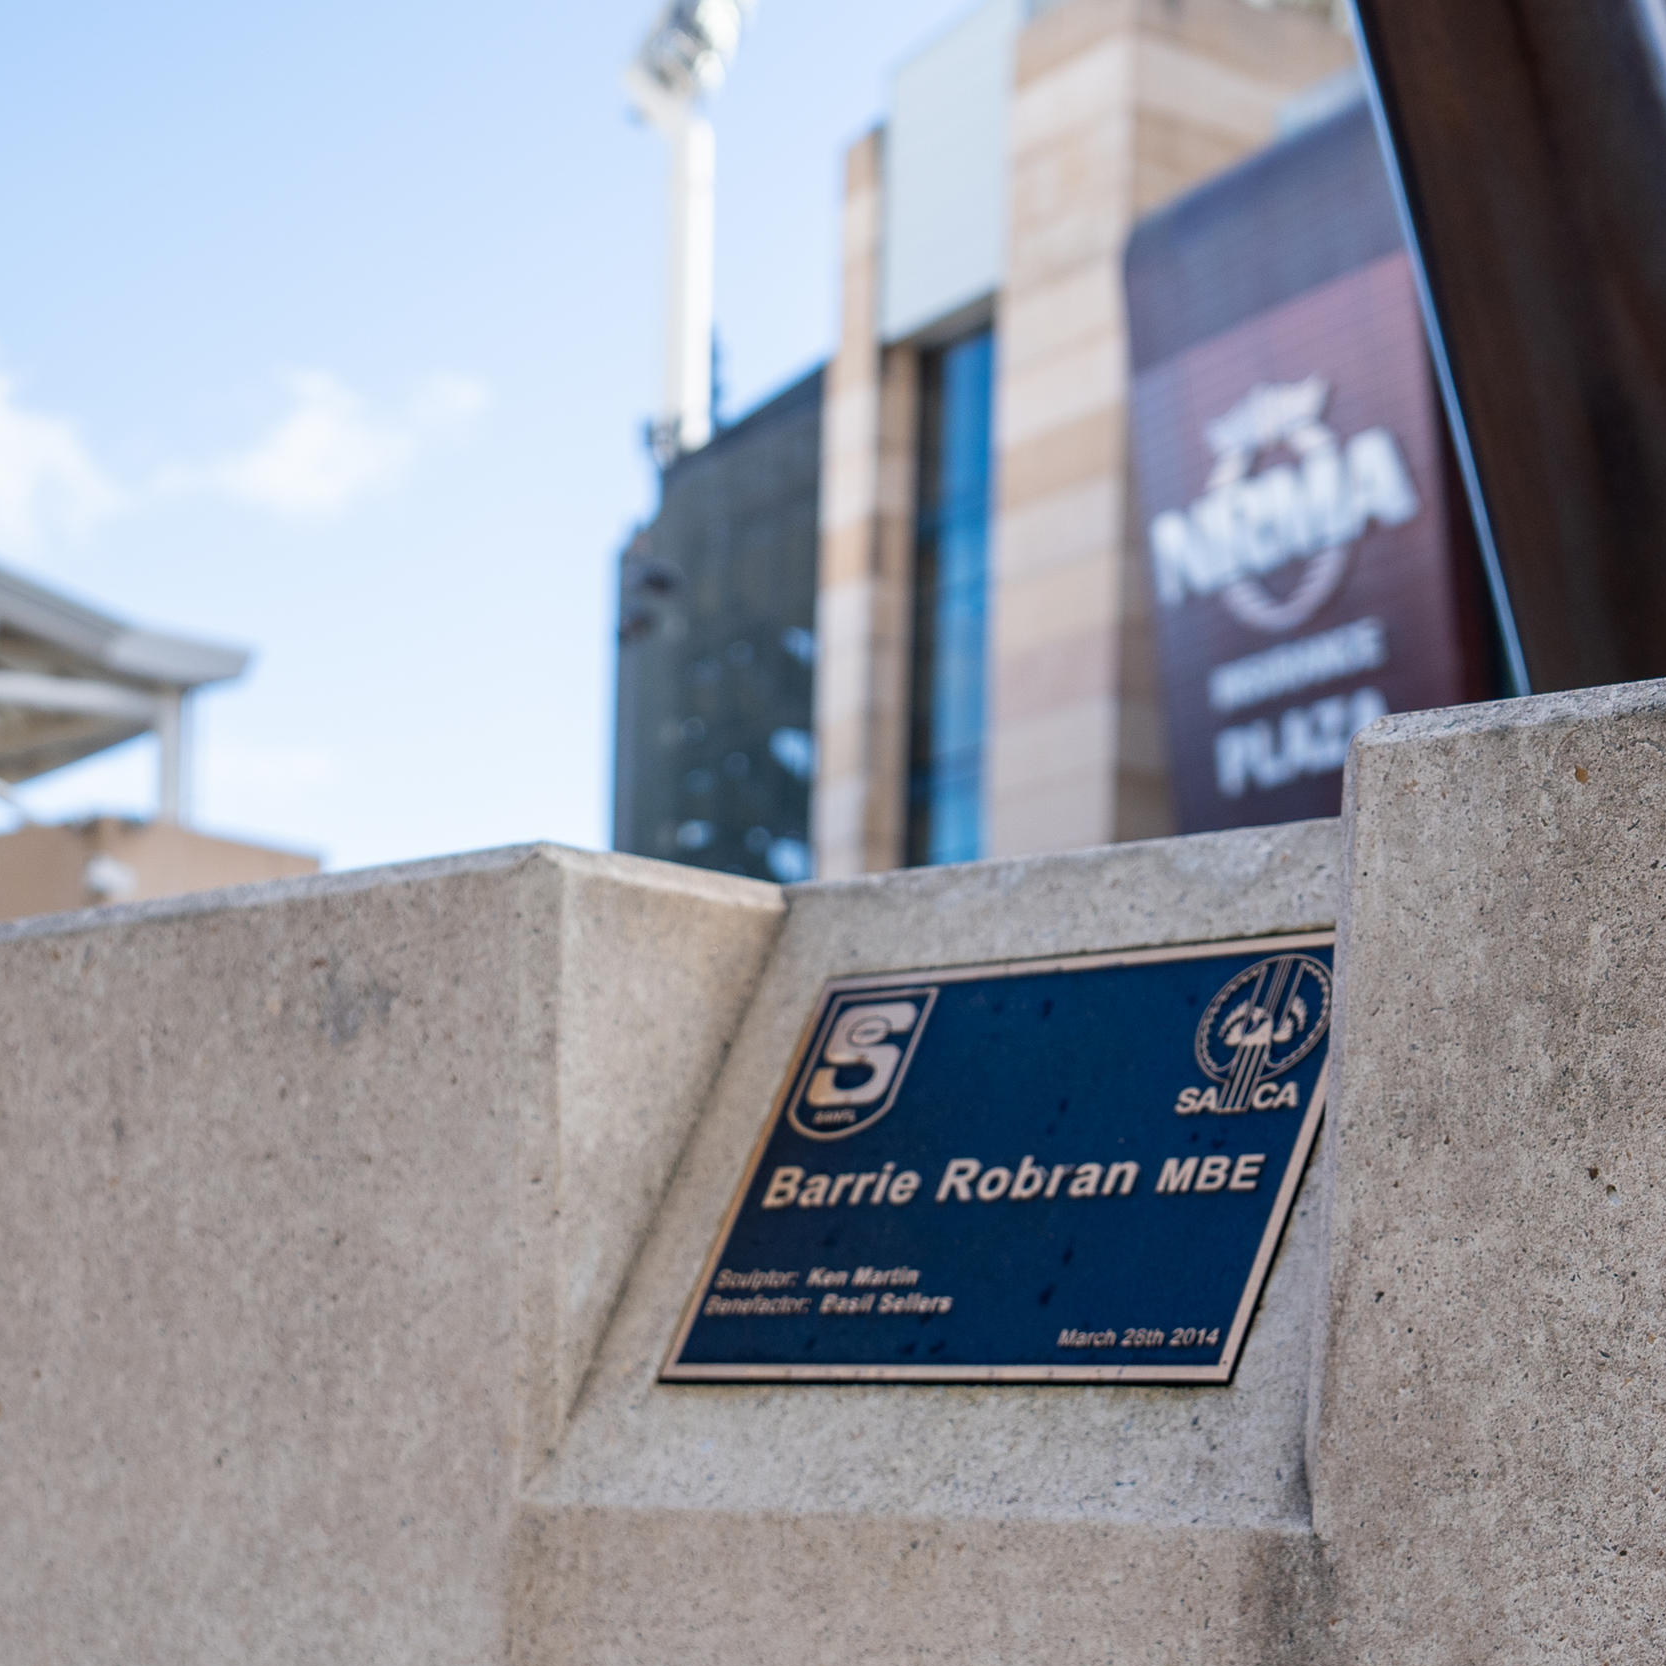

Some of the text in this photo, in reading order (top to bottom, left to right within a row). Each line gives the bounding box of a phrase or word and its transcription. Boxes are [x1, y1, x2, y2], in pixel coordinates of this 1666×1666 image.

[761, 1153, 1266, 1209] Barrie Robran MBE
[715, 1265, 921, 1291] Sculptor: Ken Martin
[703, 1292, 953, 1316] Benefactor: Basil Sellers
[1057, 1328, 1117, 1348] March
[1169, 1327, 1220, 1347] 2014
